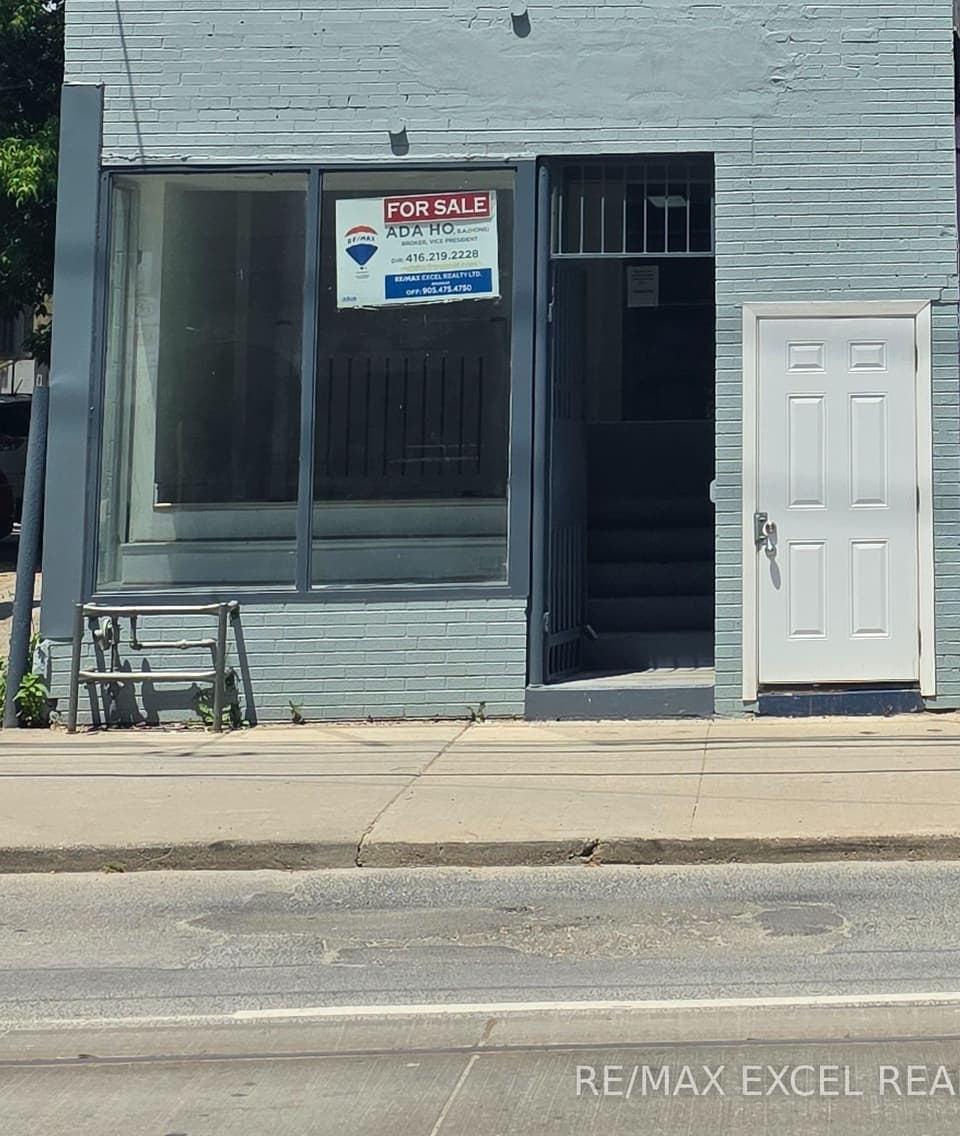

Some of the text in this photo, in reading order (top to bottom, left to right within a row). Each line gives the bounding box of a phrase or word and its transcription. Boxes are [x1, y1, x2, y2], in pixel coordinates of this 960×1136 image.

[387, 196, 487, 219] FOR SALE
[386, 224, 424, 239] ADA
[405, 249, 479, 263] 416.219.2228
[394, 274, 420, 282] RE/MAX
[421, 273, 442, 281] EXCEL
[443, 271, 468, 279] REALTY
[422, 284, 472, 295] 905.475.4750
